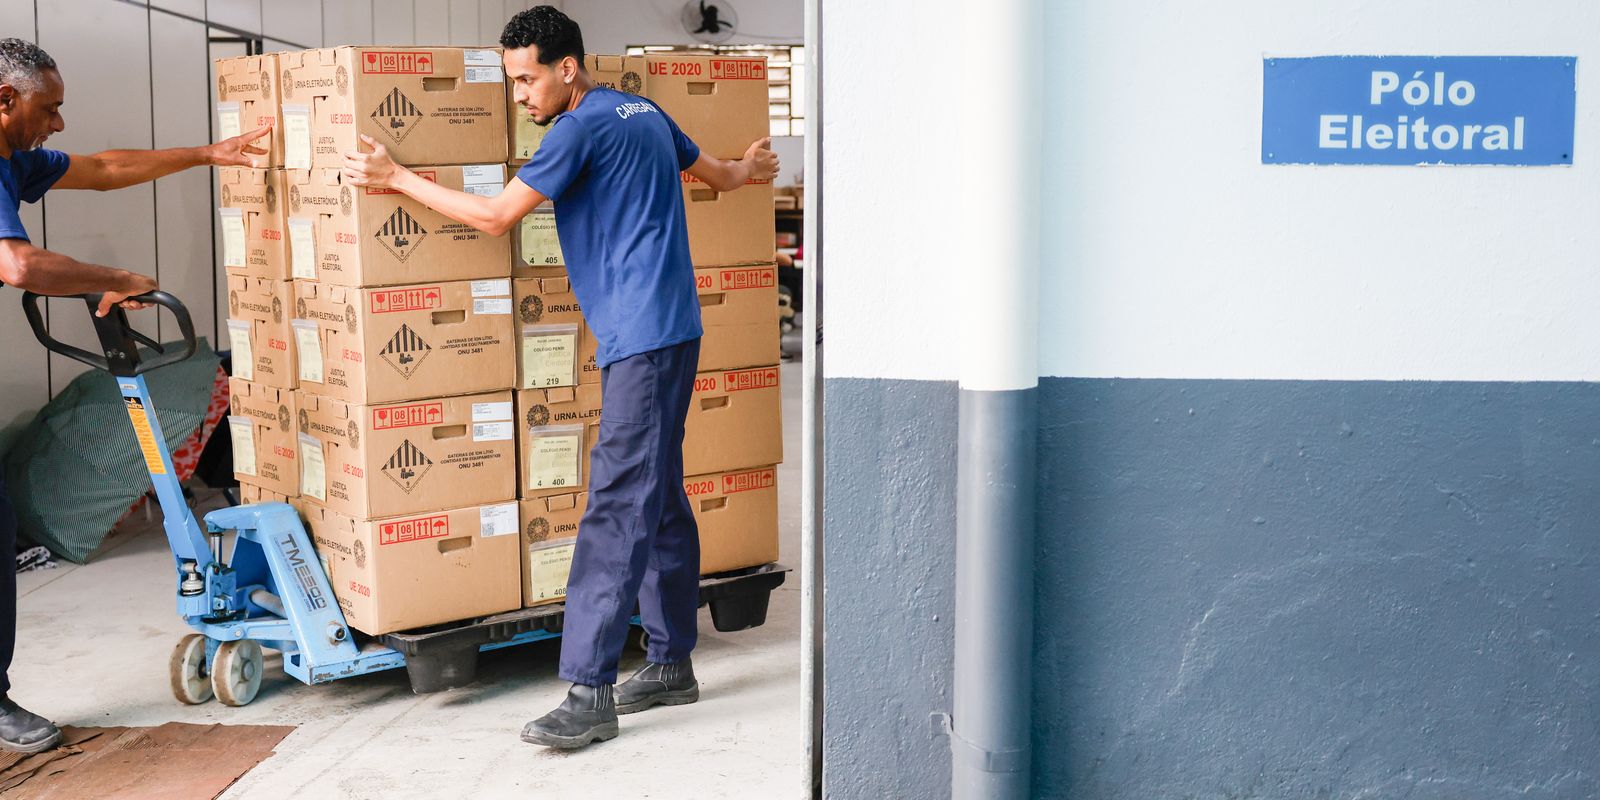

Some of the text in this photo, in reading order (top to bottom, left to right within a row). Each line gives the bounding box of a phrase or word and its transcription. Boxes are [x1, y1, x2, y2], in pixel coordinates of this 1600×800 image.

[384, 56, 395, 65] 08
[648, 62, 701, 75] UE 2020
[726, 64, 735, 72] 08
[1370, 70, 1476, 106] Pólo
[330, 114, 353, 124] UE 2020
[1319, 114, 1525, 151] Eleitoral
[335, 232, 356, 244] UE 2020
[392, 294, 403, 303] 08
[548, 304, 571, 313] URNA
[741, 375, 749, 383] 08
[694, 378, 716, 391] 020
[394, 410, 405, 420] 08
[554, 412, 577, 421] URNA
[274, 445, 294, 459] UE 2020
[686, 481, 714, 496] 2020
[401, 524, 412, 534] 08
[554, 524, 577, 533] URNA
